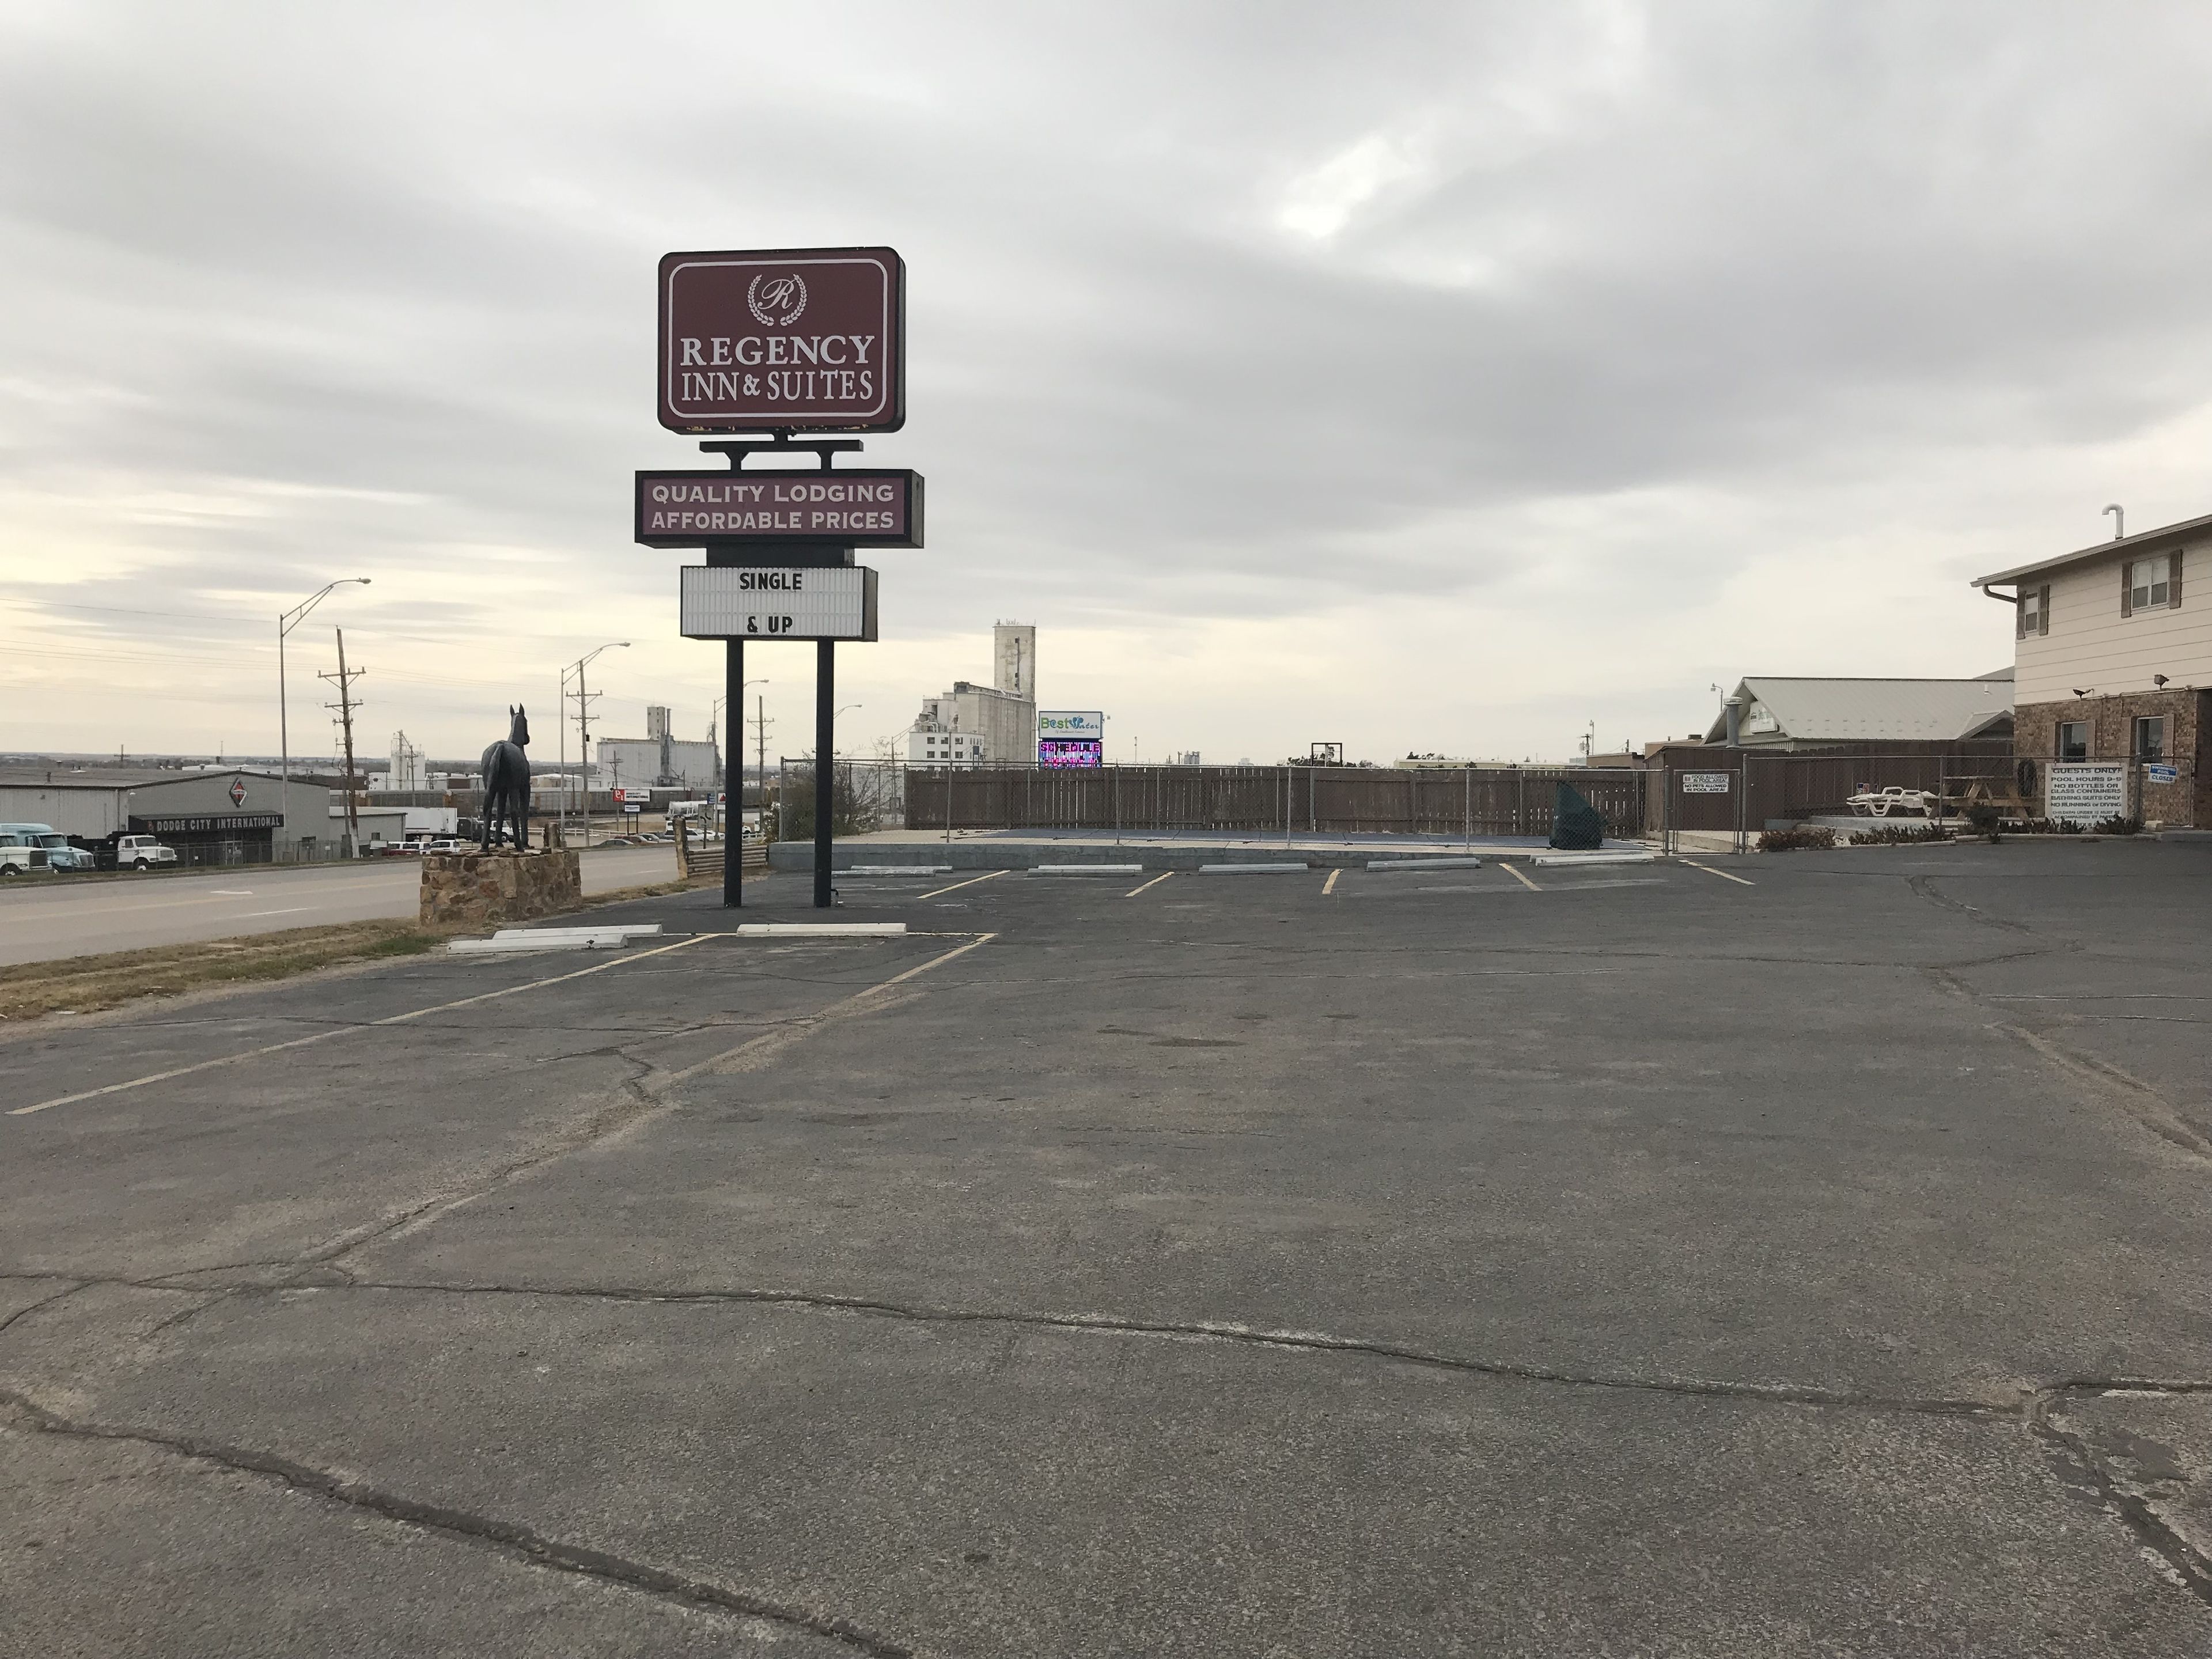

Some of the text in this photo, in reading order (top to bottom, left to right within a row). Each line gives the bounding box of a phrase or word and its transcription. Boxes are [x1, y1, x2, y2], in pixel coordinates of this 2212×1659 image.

[680, 335, 874, 366] REGENCY
[681, 370, 873, 401] INN & SUITES
[652, 485, 894, 504] QUALITY LODGING
[652, 512, 894, 529] AFFORDABLE PRICES
[740, 573, 802, 590] SINGLE
[747, 616, 793, 632] & UP
[1041, 717, 1069, 729] Best
[157, 819, 185, 831] DODGE
[190, 819, 211, 830] CITY
[217, 816, 280, 829] INTERNATIONAL
